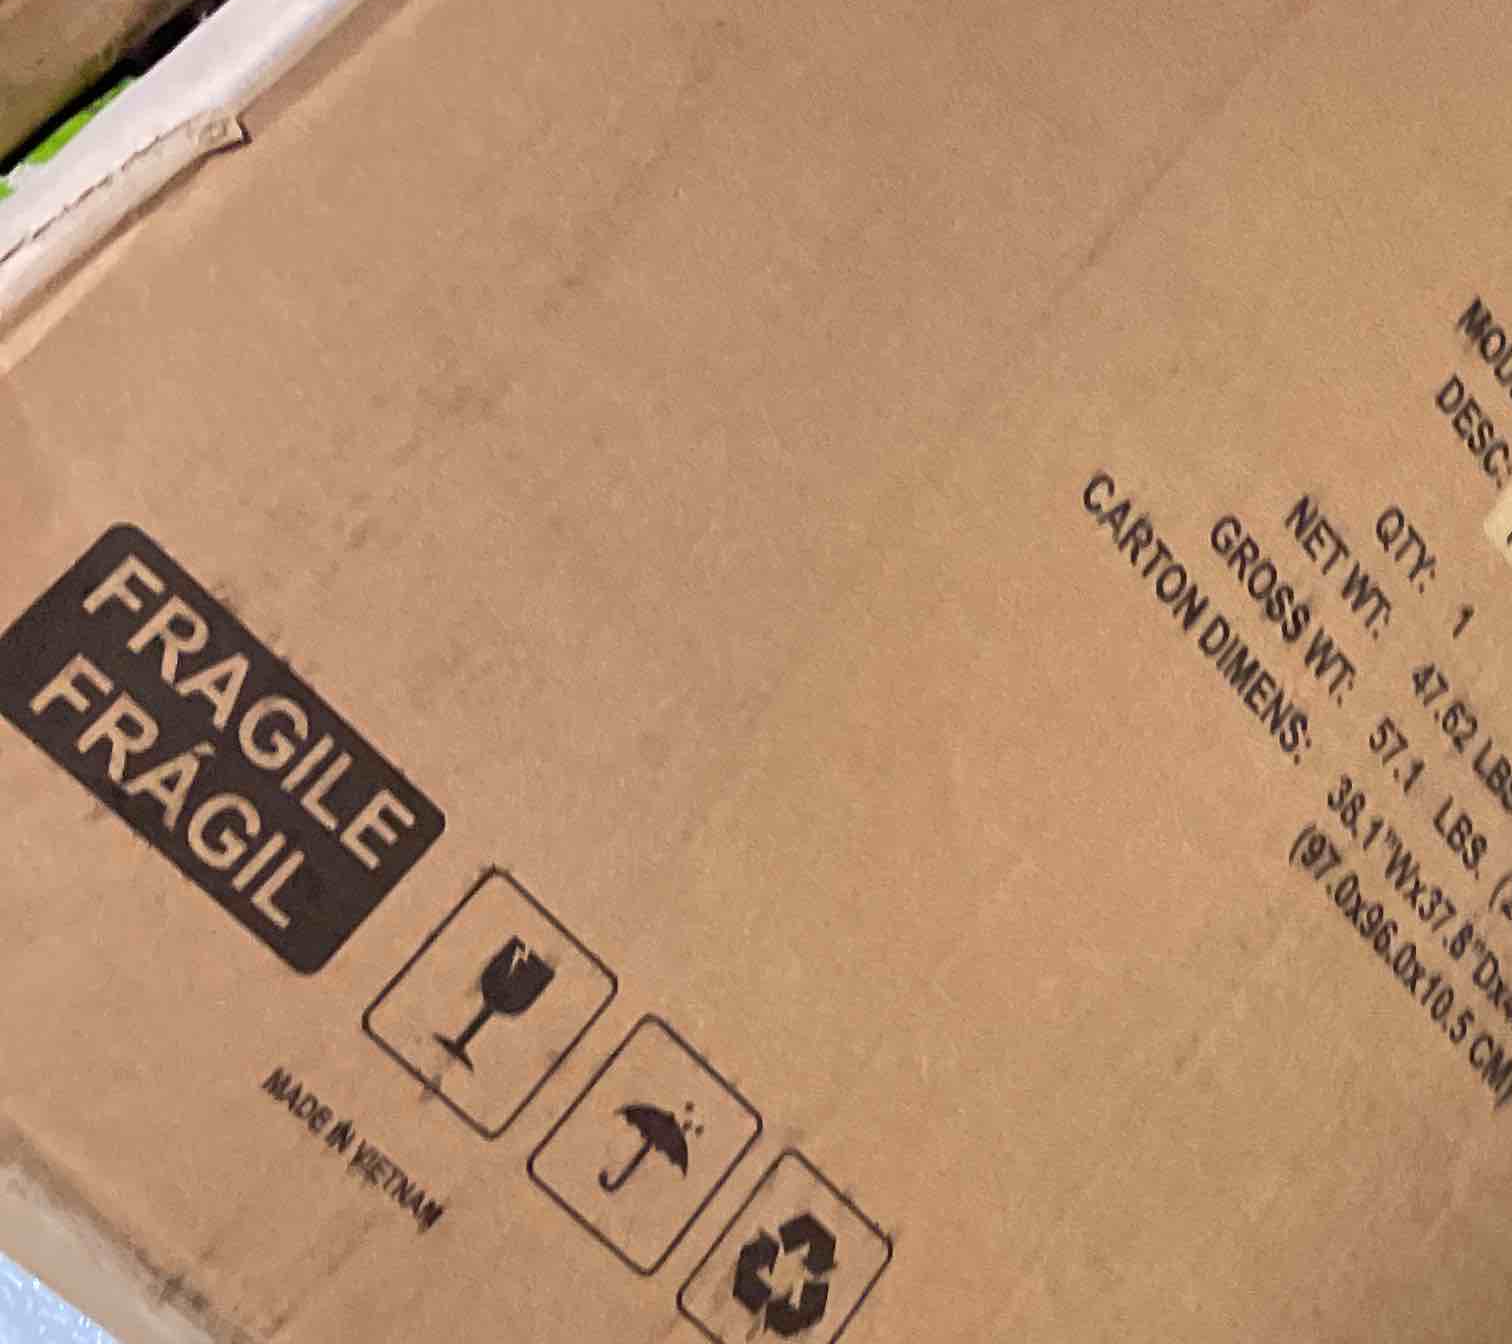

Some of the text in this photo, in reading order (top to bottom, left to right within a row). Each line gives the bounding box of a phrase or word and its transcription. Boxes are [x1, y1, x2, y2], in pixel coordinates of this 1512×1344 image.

[1434, 372, 1512, 489] DESC:
[1081, 472, 1210, 633] CARTON
[1196, 613, 1312, 766] DIMENS:
[1209, 514, 1311, 644] GROSS
[1302, 625, 1356, 707] WT:
[1367, 715, 1425, 795] 57.1
[1431, 794, 1488, 881] LBS.
[1283, 493, 1350, 576] NET
[1339, 559, 1392, 640] WT:
[1411, 662, 1479, 755] 47.62
[1374, 505, 1475, 639] QTY: 1
[29, 654, 310, 930] FRÁGIL
[82, 554, 415, 870] FRAGILE
[260, 1066, 446, 1234] MADE IN VIETNAM
